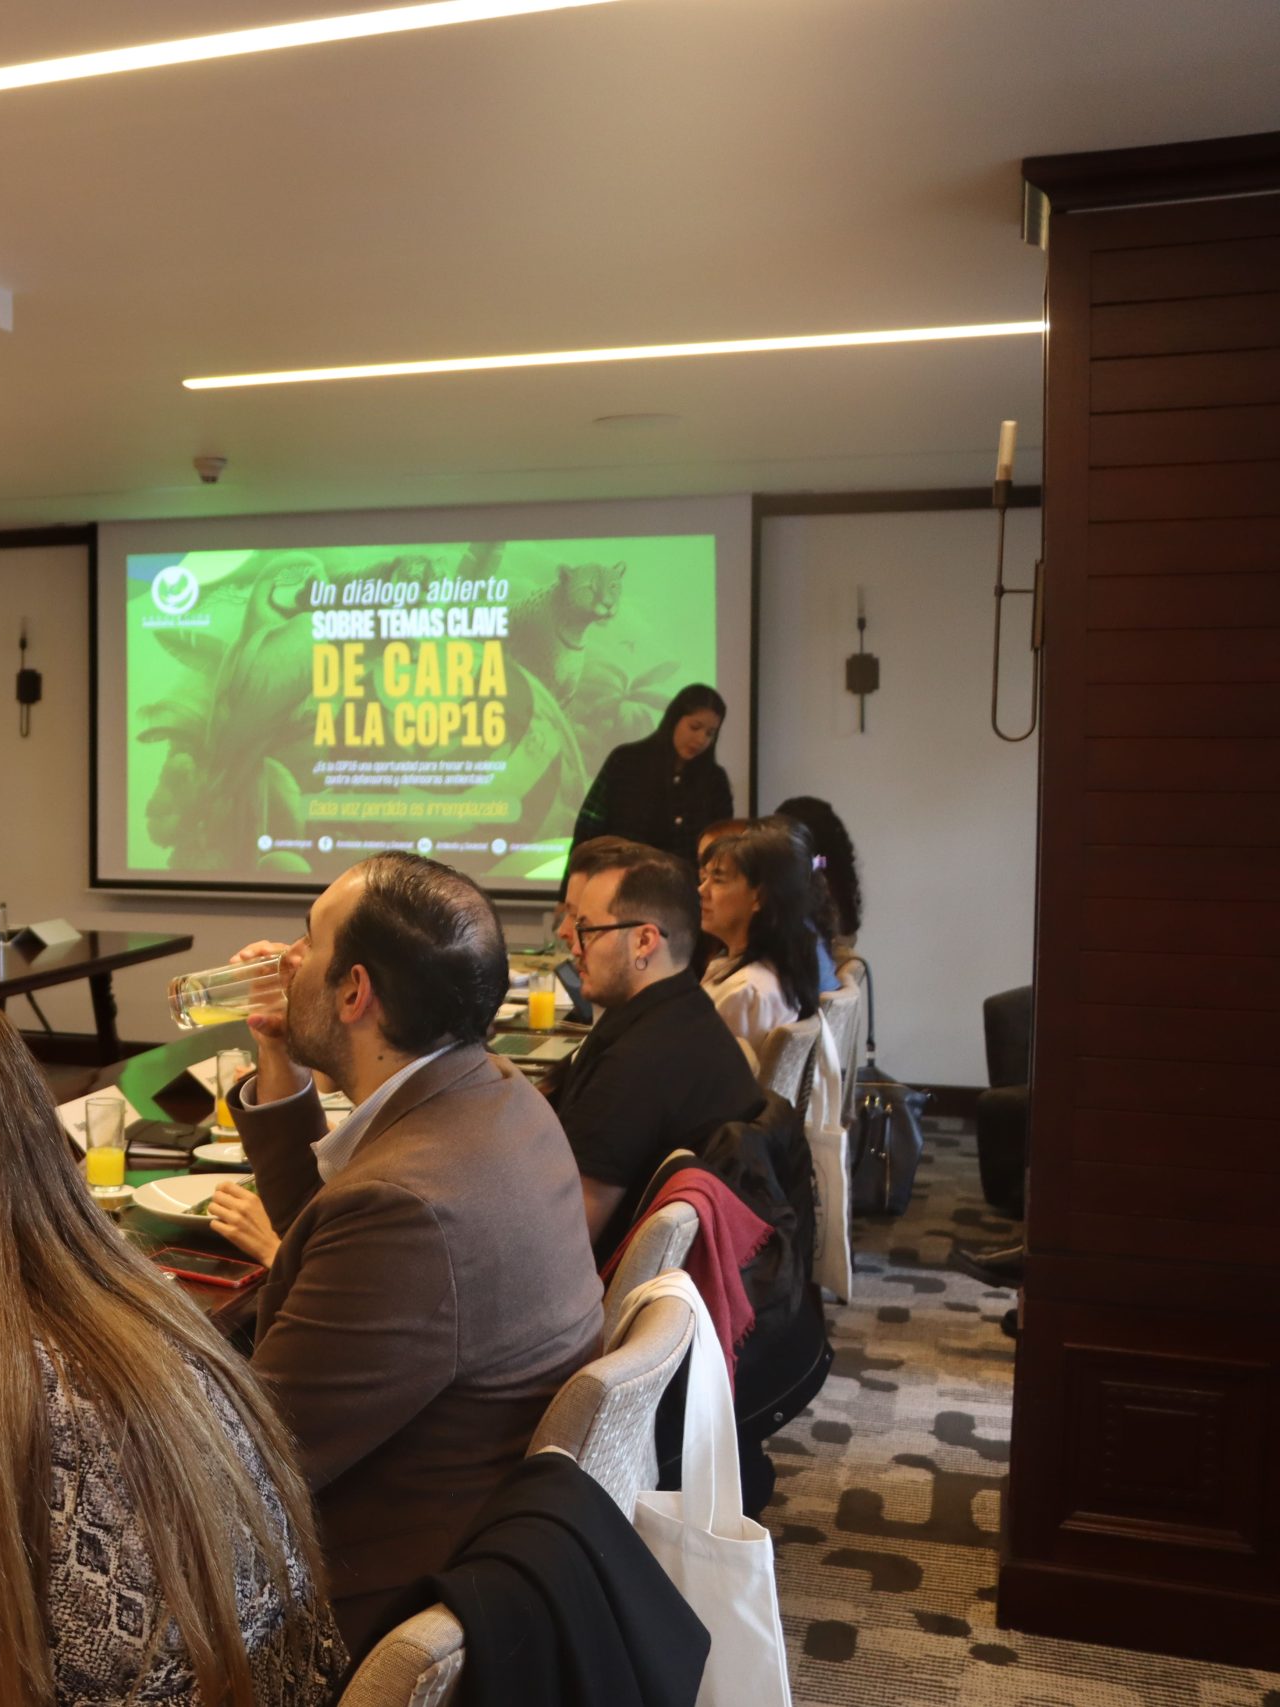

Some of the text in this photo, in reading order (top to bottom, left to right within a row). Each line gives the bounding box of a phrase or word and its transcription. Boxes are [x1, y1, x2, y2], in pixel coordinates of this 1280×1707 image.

[310, 576, 509, 609] Un diálogo abierto
[311, 606, 509, 640] SOBRE TEMAS CLAVE
[312, 640, 508, 698] DE CARA
[313, 700, 506, 747] A LA COP16
